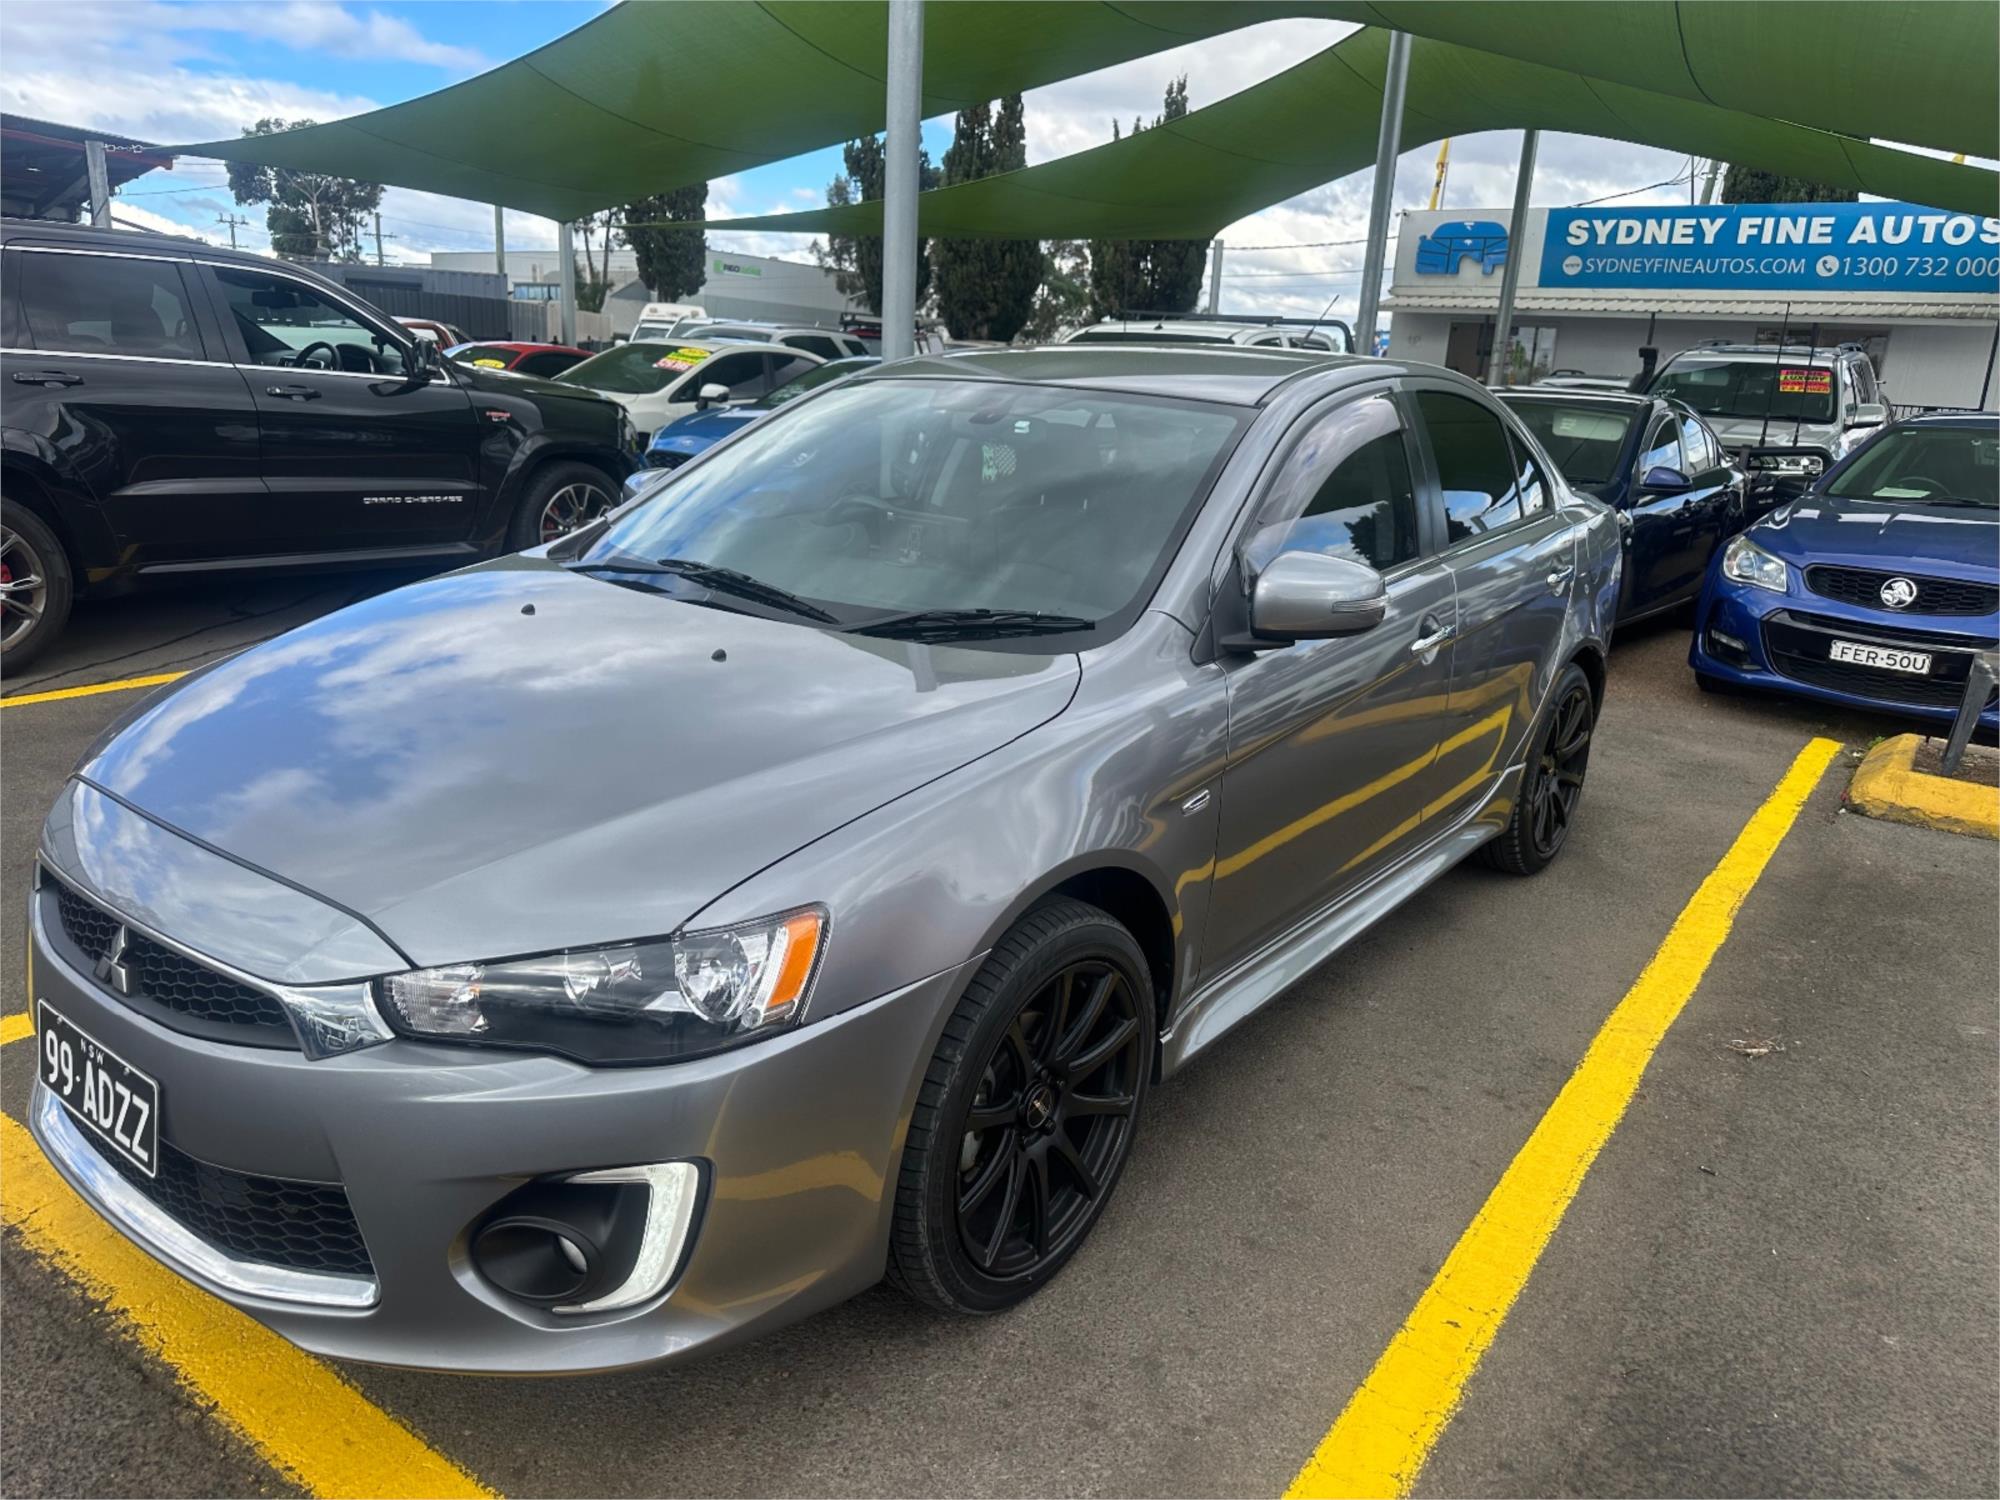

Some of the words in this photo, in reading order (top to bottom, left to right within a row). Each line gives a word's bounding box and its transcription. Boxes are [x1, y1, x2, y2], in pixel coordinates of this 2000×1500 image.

[1566, 217, 1727, 246] SYDNEY
[1737, 216, 1836, 245] FINE
[1847, 215, 2000, 246] AUTOS
[1585, 257, 1806, 274] SYDNEYFINEAUTOS.COM
[1842, 256, 1898, 277] 1300
[1904, 256, 1949, 277] 732
[1955, 256, 2000, 277] 000
[80, 1038, 105, 1066] NSW
